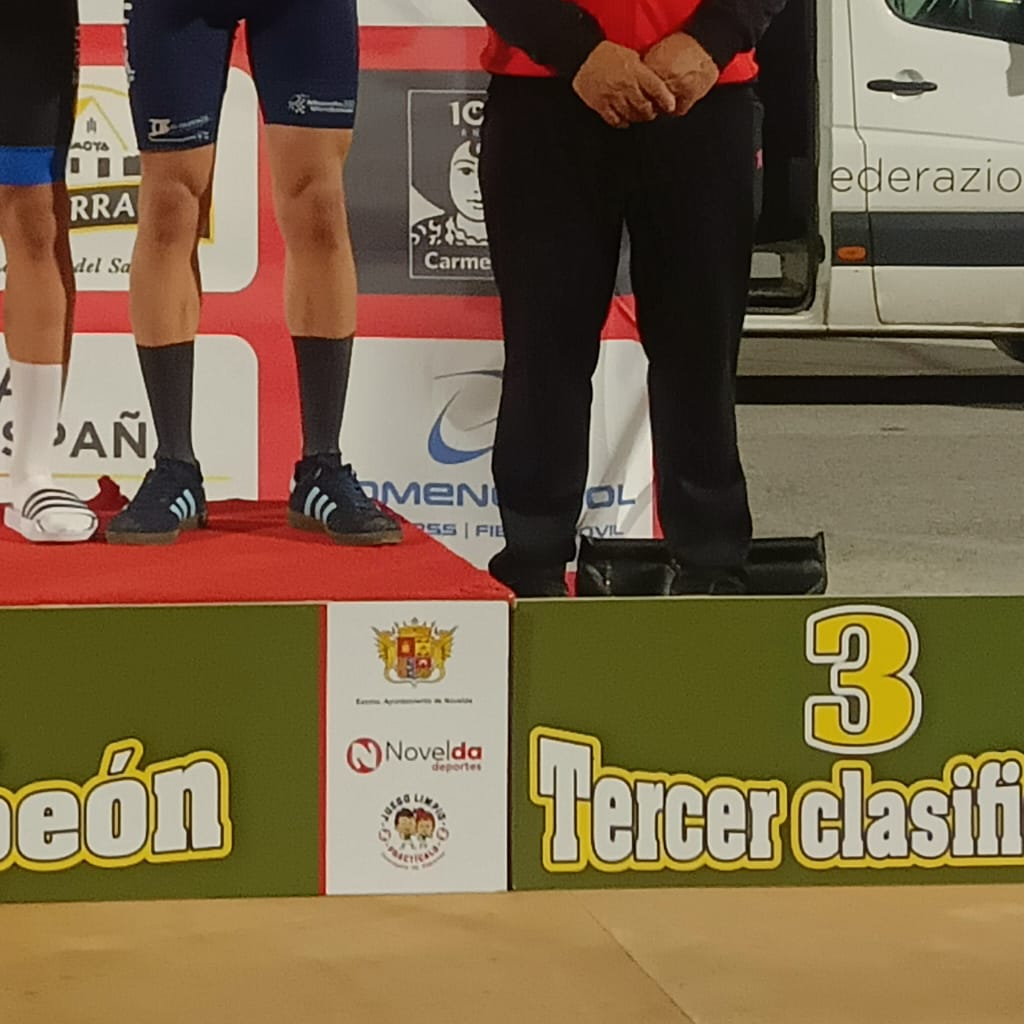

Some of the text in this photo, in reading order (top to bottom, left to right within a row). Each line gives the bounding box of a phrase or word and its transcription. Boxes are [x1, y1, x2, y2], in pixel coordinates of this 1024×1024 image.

[830, 157, 1023, 193] ederazio
[806, 605, 923, 755] 3
[386, 740, 482, 761] Novelda
[432, 762, 482, 773] deportes
[534, 731, 1024, 868] Tercer clasifi
